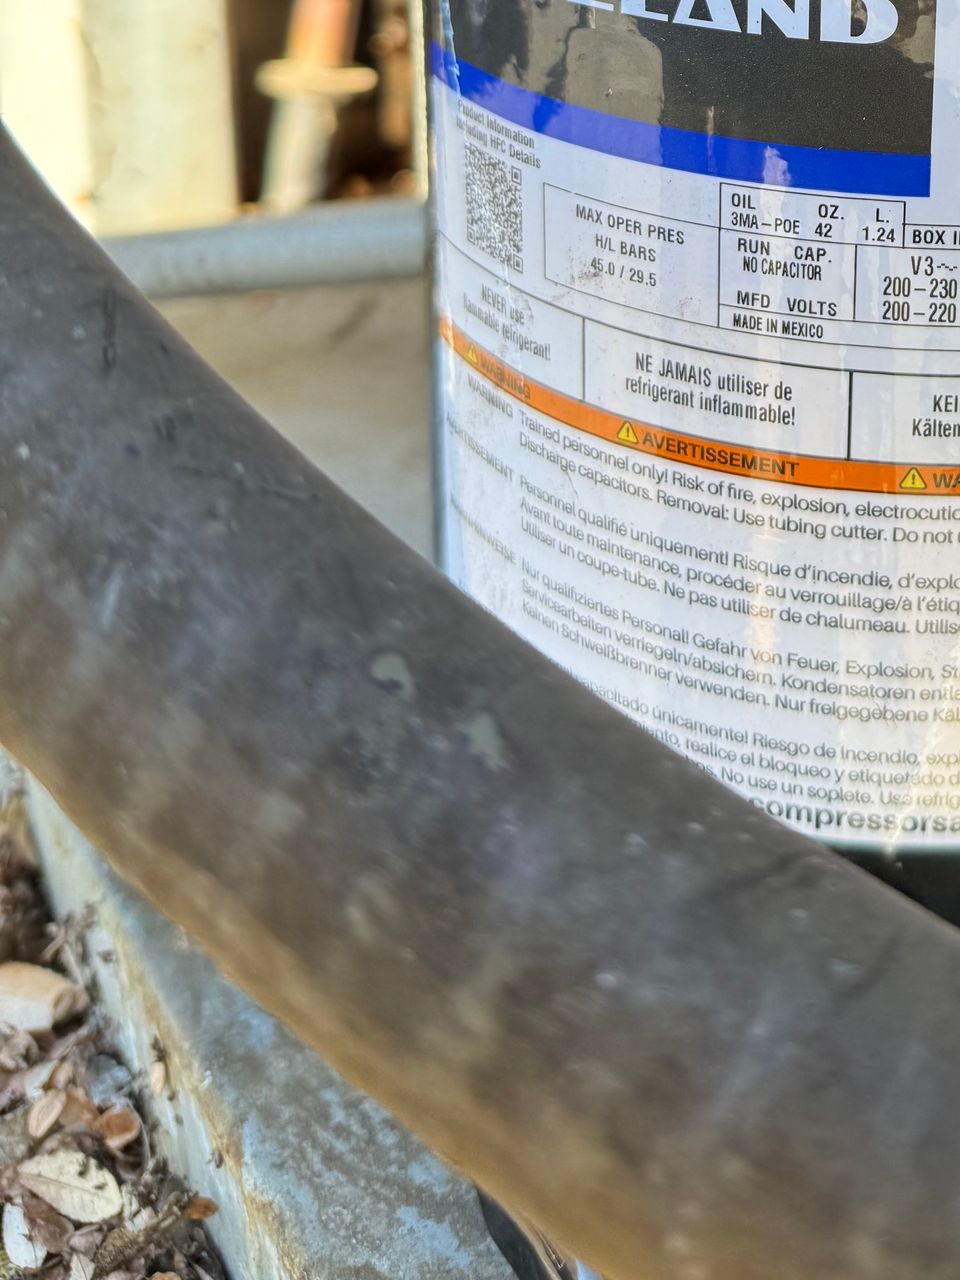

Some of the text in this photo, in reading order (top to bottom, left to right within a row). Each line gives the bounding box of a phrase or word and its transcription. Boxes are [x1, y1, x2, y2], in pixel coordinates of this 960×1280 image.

[509, 145, 541, 169] Details
[731, 192, 889, 223] OIL OZ. L.
[576, 204, 685, 245] MAX OPER PRES
[815, 223, 832, 238] 42
[862, 226, 895, 243] 1.24
[912, 230, 945, 245] BOX
[595, 233, 656, 262] H/L BARS
[737, 237, 832, 263] RUN CAP.
[590, 257, 615, 276] 45.0
[629, 267, 657, 287] 29.5
[743, 256, 822, 281] NO CAPACITOR
[482, 283, 507, 312] NEVER
[737, 290, 837, 317] MFD VOLTS
[733, 313, 824, 339] MADE IN MEXICO
[635, 351, 793, 401] NE JAMAIS utiliser de
[625, 377, 795, 426] refrigerant inflammable!
[520, 409, 561, 444] Trained
[564, 431, 629, 472] personnel
[632, 459, 668, 485] only!
[672, 470, 704, 492] Risk
[708, 479, 725, 497] of
[728, 483, 757, 506] fire,
[761, 492, 849, 518] explosion,
[642, 432, 799, 477] AVERTISSEMENT
[520, 431, 576, 473] Discharge
[579, 463, 653, 502] capacitors.
[657, 490, 729, 522] Removal:
[734, 507, 765, 527] Use
[769, 514, 826, 539] tubing
[831, 523, 887, 542] cutter.
[893, 527, 918, 543] Do
[924, 529, 953, 544] not
[520, 475, 576, 516] Personnel
[579, 505, 627, 538] qualifié
[630, 525, 729, 567] uniquement!
[734, 554, 792, 579] Risque
[520, 497, 550, 525] Avant
[553, 512, 584, 541] toute
[687, 566, 760, 595] procéder
[577, 545, 660, 593] coupe-tube.
[664, 580, 686, 599] Ne
[688, 586, 718, 612] pas
[721, 593, 776, 619] utiliser
[779, 608, 802, 623] de
[806, 610, 910, 633] chalumeau.
[622, 610, 689, 644] Personal!
[693, 632, 748, 659] Gefahr
[751, 649, 782, 666] von
[788, 653, 839, 674] Feuer,
[846, 660, 936, 680] Explosion,
[675, 670, 770, 707] verwenden.
[776, 694, 805, 712] Nur
[782, 674, 915, 700] Kondensatoren
[685, 739, 831, 780] realice bloqueo
[753, 732, 810, 757] Riesgo
[748, 775, 778, 790] use
